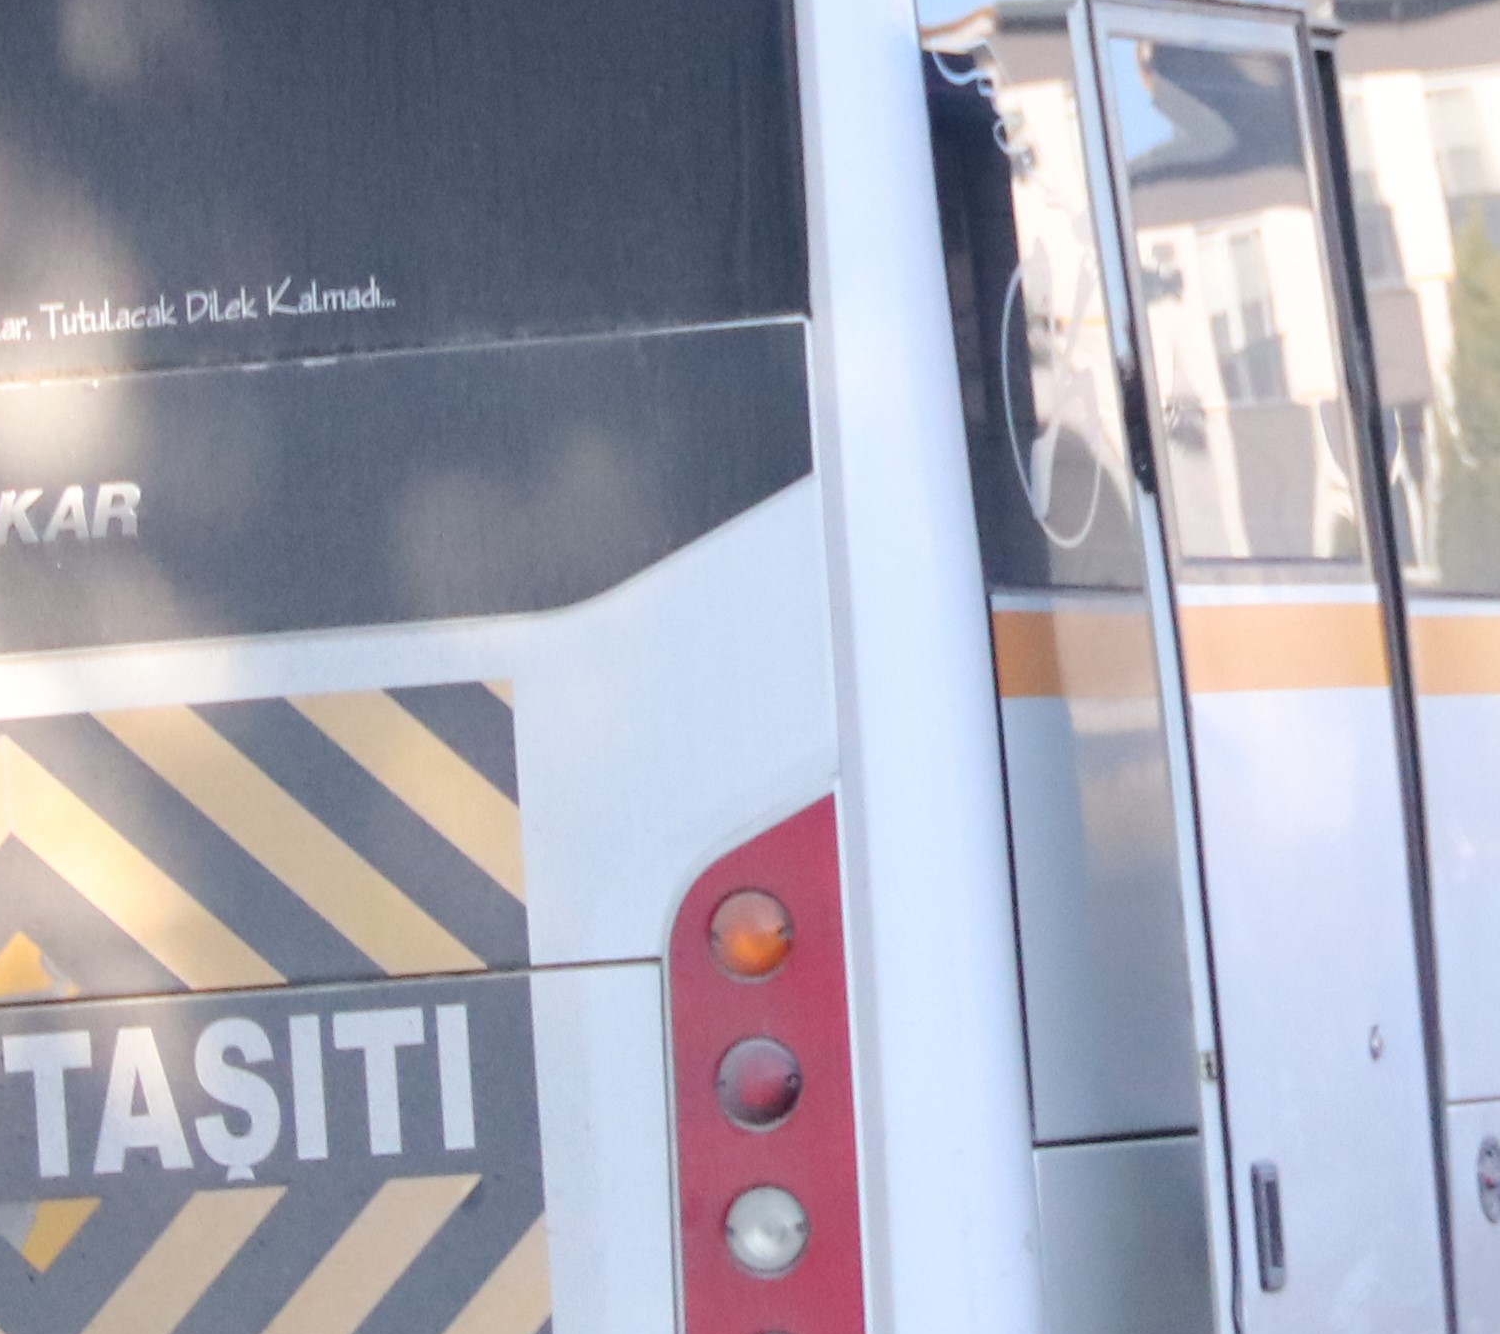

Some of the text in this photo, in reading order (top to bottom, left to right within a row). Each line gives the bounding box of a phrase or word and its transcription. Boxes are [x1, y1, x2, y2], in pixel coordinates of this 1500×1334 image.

[40, 293, 177, 340] Tutulacak
[186, 286, 258, 324] Dilek
[3, 1004, 477, 1181] TAŞITI
